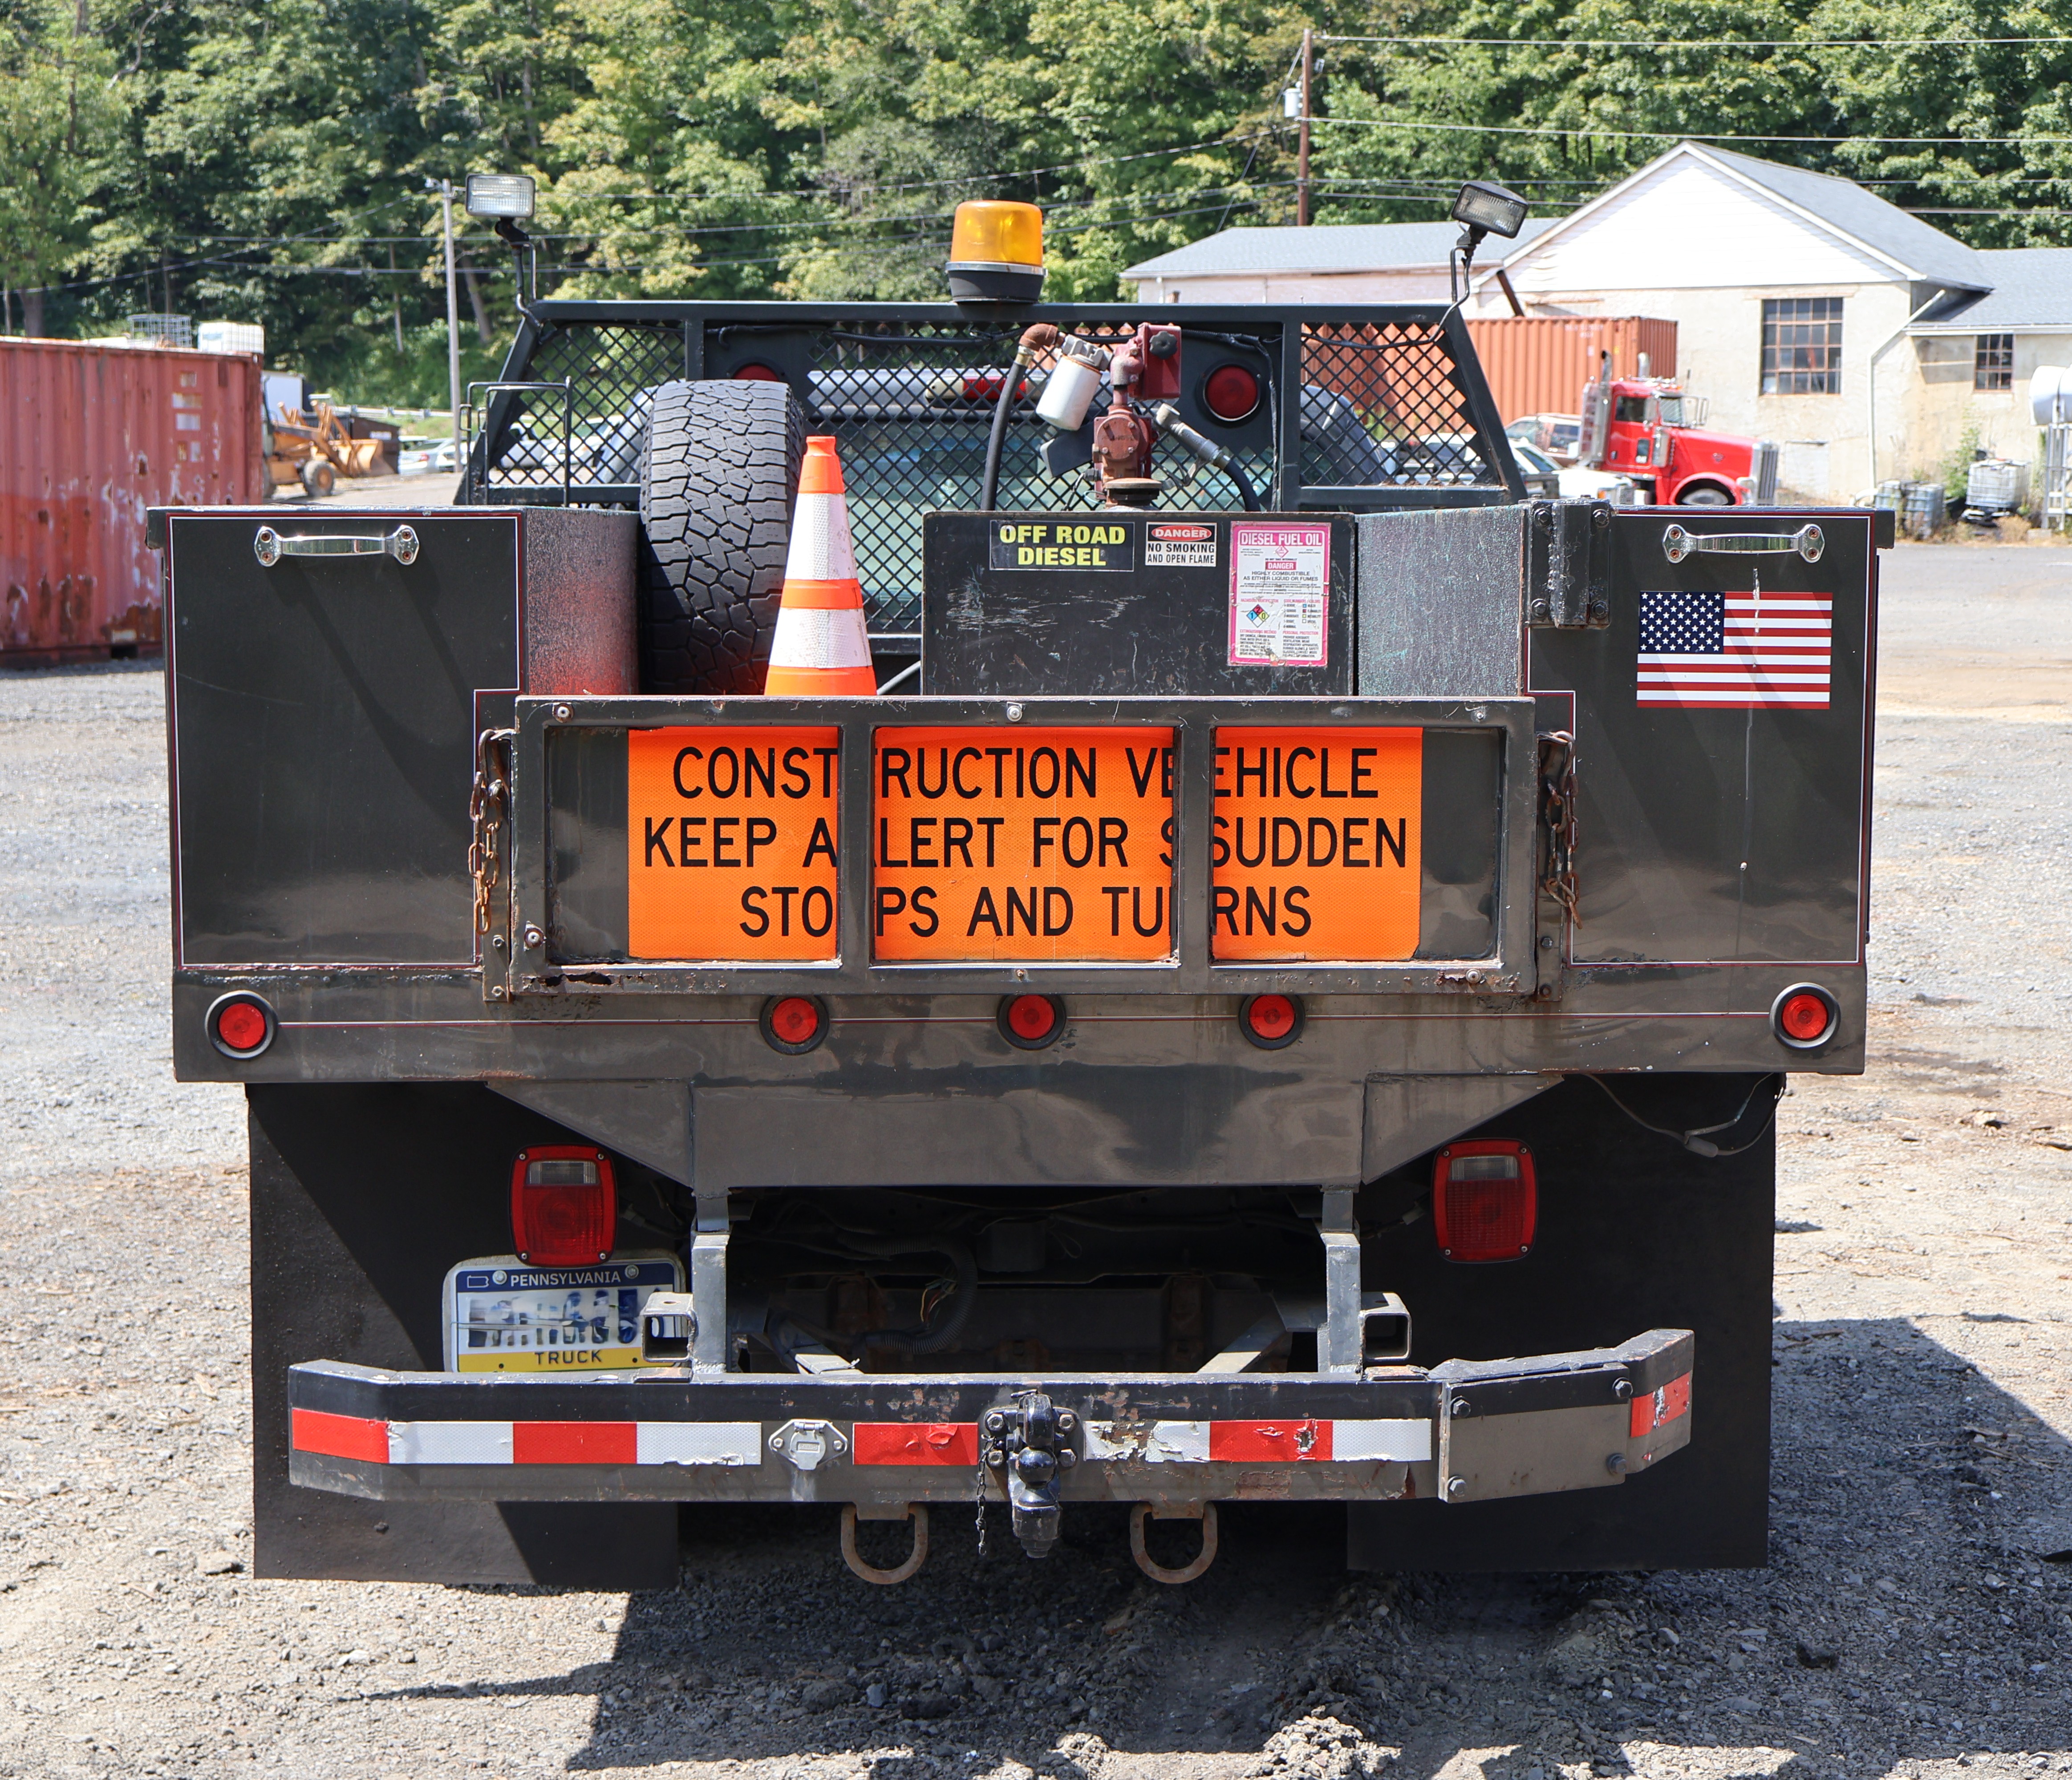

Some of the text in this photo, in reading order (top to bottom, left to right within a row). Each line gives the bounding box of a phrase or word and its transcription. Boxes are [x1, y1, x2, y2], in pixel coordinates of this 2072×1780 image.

[999, 525, 1126, 545] OFF ROAD
[1155, 529, 1208, 538] DANGER
[1241, 533, 1322, 546] DIESEL FUEL OIL
[1018, 547, 1107, 566] DIESEL
[1148, 543, 1215, 553] NO SMOKING
[1147, 554, 1215, 564] AND OPEN FLAME
[673, 746, 1096, 799] CONSTRUCTION
[645, 817, 778, 868] KEEP
[802, 817, 1005, 868] ALERT
[1033, 816, 1129, 868] FOR
[739, 886, 1311, 938] STOPS AND TURNS
[510, 1270, 621, 1287] PENNSYLVANIA
[535, 1350, 603, 1365] TRUCK
